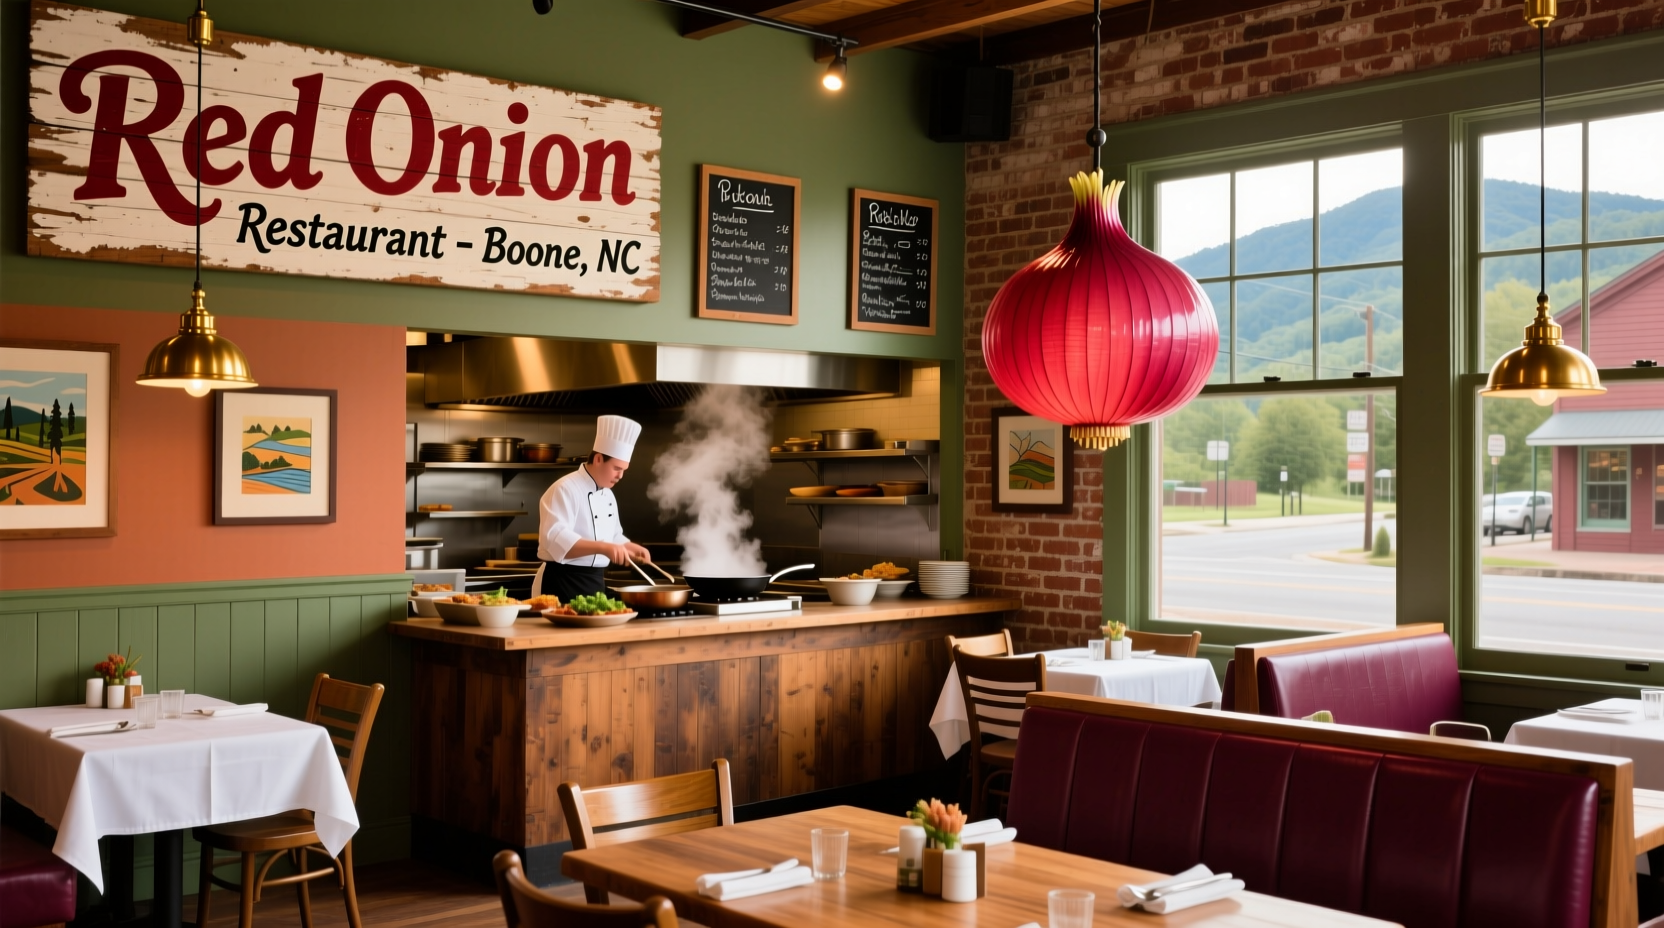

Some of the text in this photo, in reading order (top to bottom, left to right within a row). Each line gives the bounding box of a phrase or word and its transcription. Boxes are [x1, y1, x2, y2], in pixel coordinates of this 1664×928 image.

[59, 48, 636, 226] Red Onion
[236, 202, 446, 260] Restaurant
[481, 226, 589, 277] Boone,
[596, 238, 642, 275] NC
